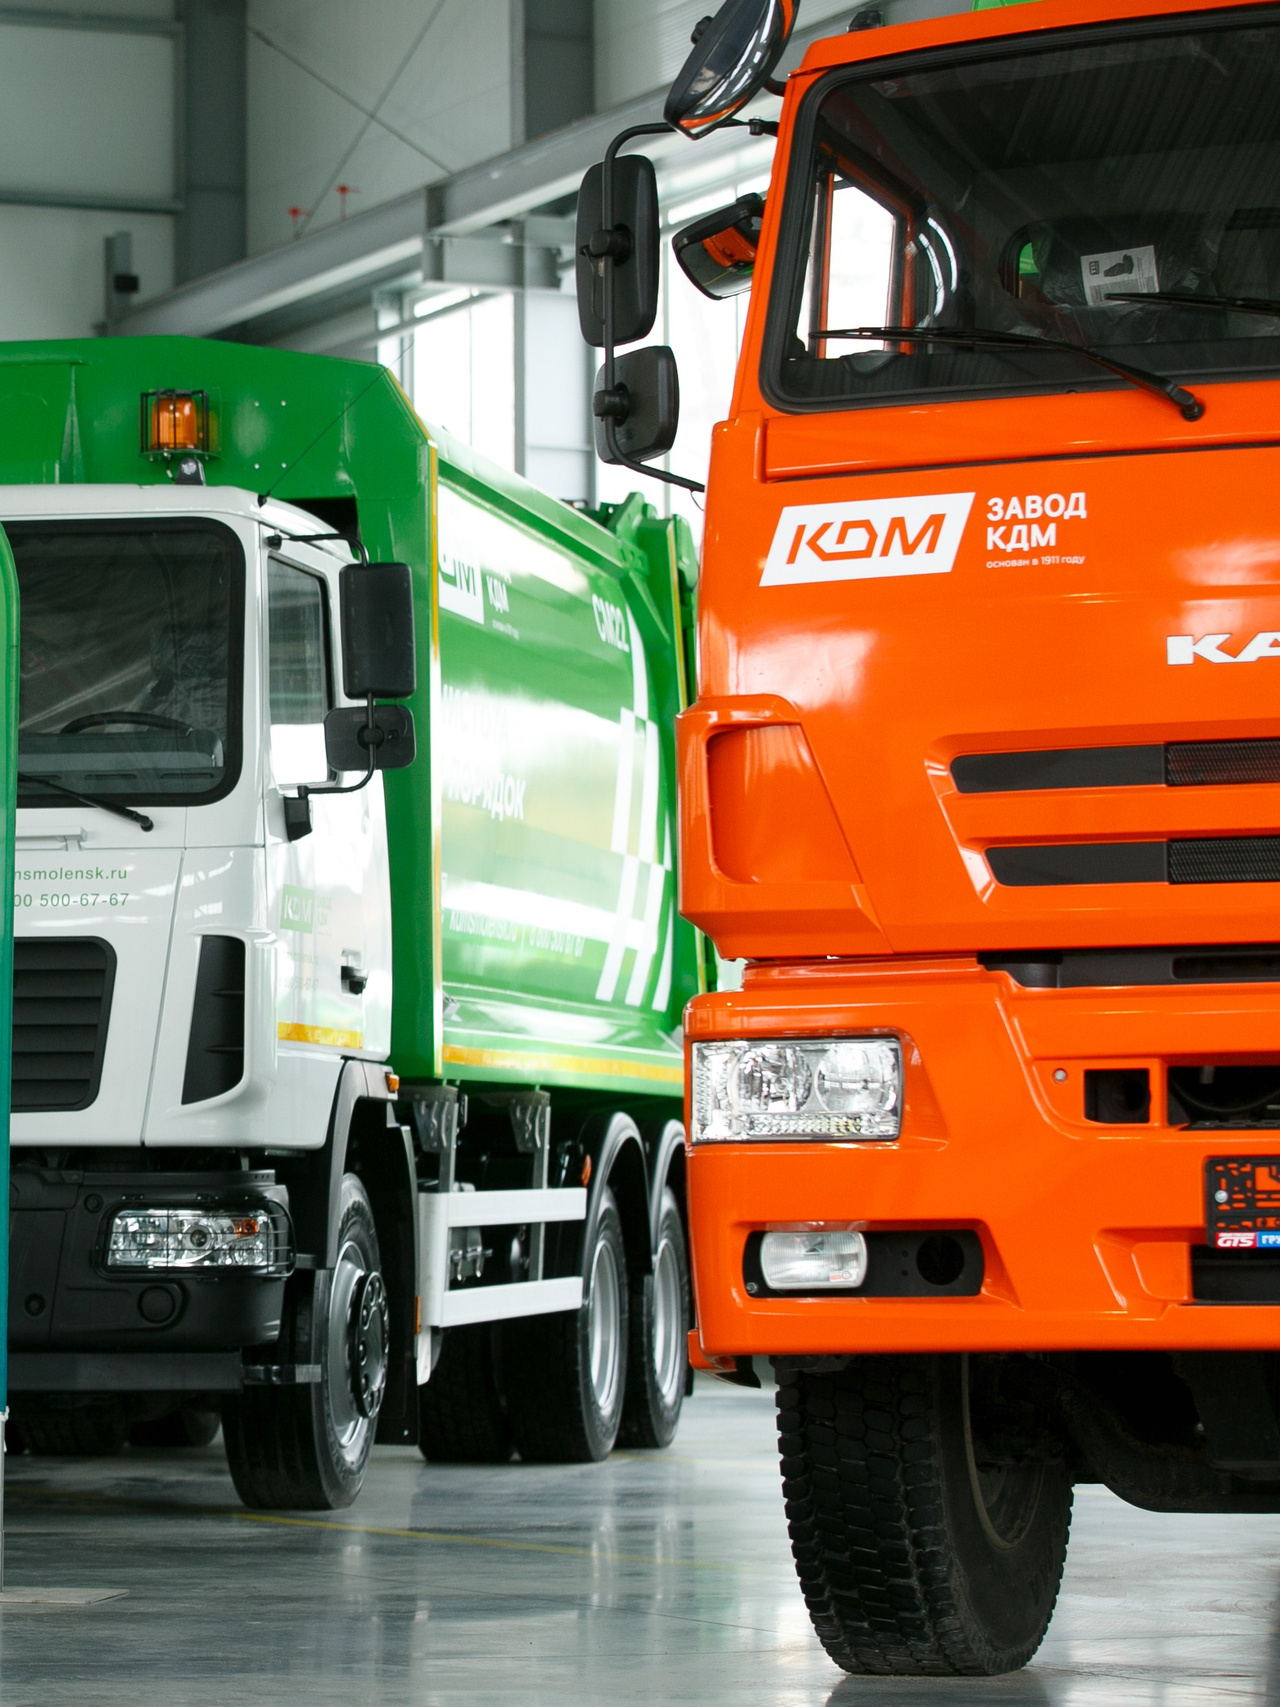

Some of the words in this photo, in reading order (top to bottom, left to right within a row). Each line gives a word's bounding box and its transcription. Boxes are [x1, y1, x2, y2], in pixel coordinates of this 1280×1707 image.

[986, 492, 1087, 521] ЗАВОД
[785, 513, 947, 565] KDM
[986, 523, 1056, 553] КДМ
[986, 558, 1030, 569] основан
[1032, 558, 1039, 566] в
[1041, 555, 1060, 565] 1911
[1061, 555, 1086, 566] году
[39, 893, 130, 907] 500-67-67
[1217, 1237, 1254, 1247] GTS
